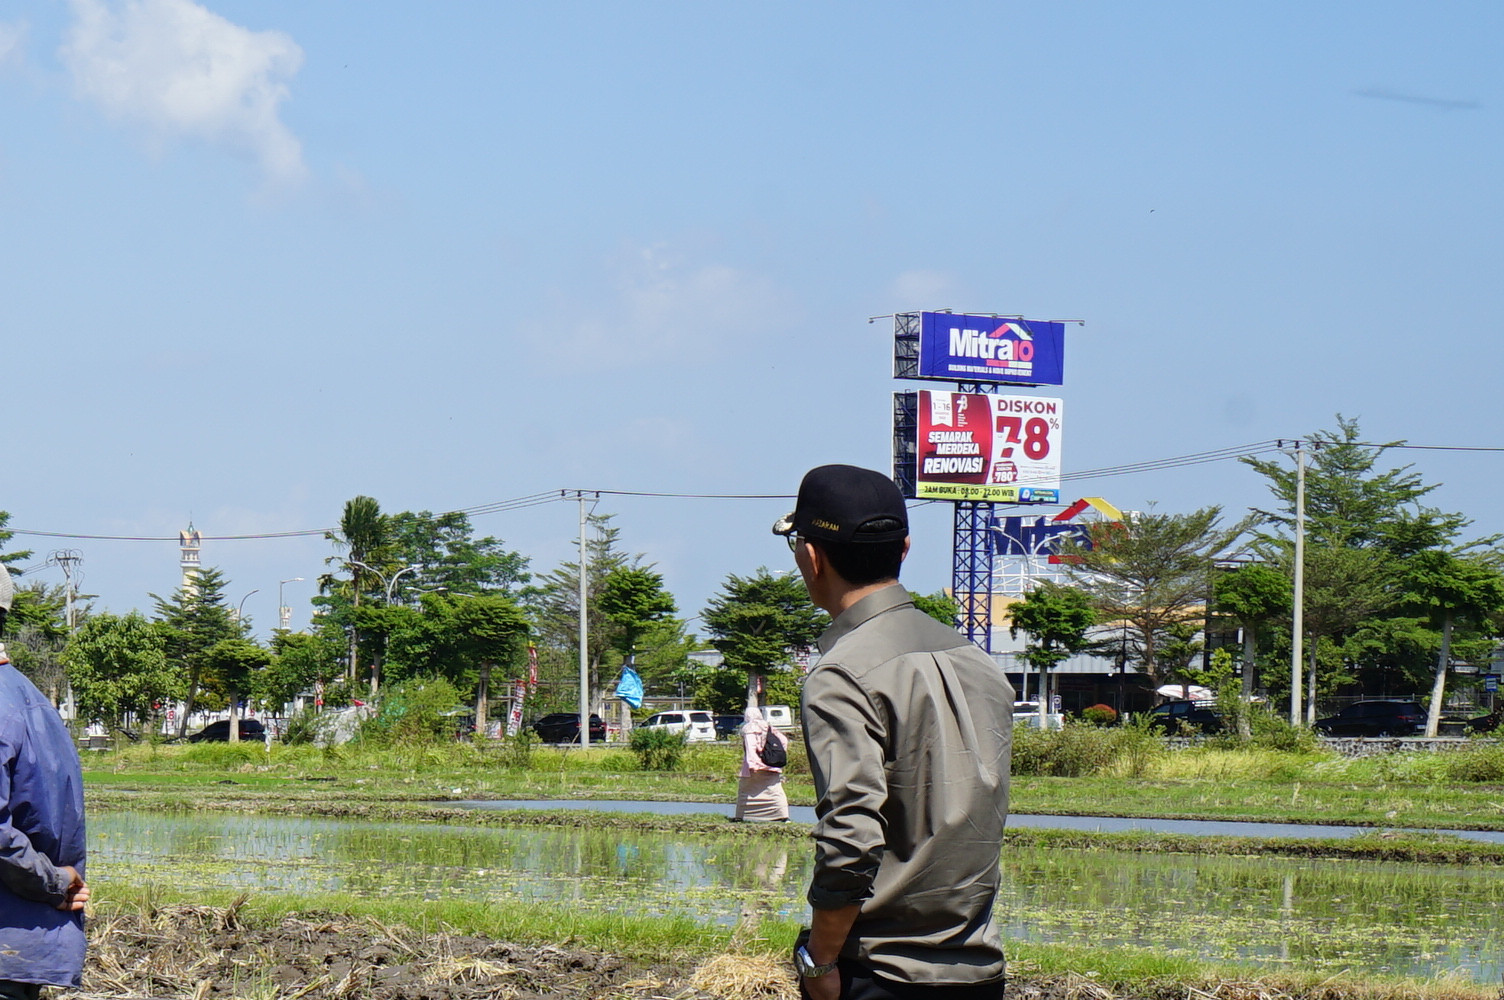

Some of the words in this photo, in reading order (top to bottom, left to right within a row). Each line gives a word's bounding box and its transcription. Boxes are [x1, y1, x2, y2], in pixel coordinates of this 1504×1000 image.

[949, 328, 1033, 361] Mitra10
[997, 399, 1056, 414] DISKON
[928, 431, 973, 443] SEMARAK
[936, 443, 980, 455] MERDEKA
[923, 457, 984, 474] RENOVASI
